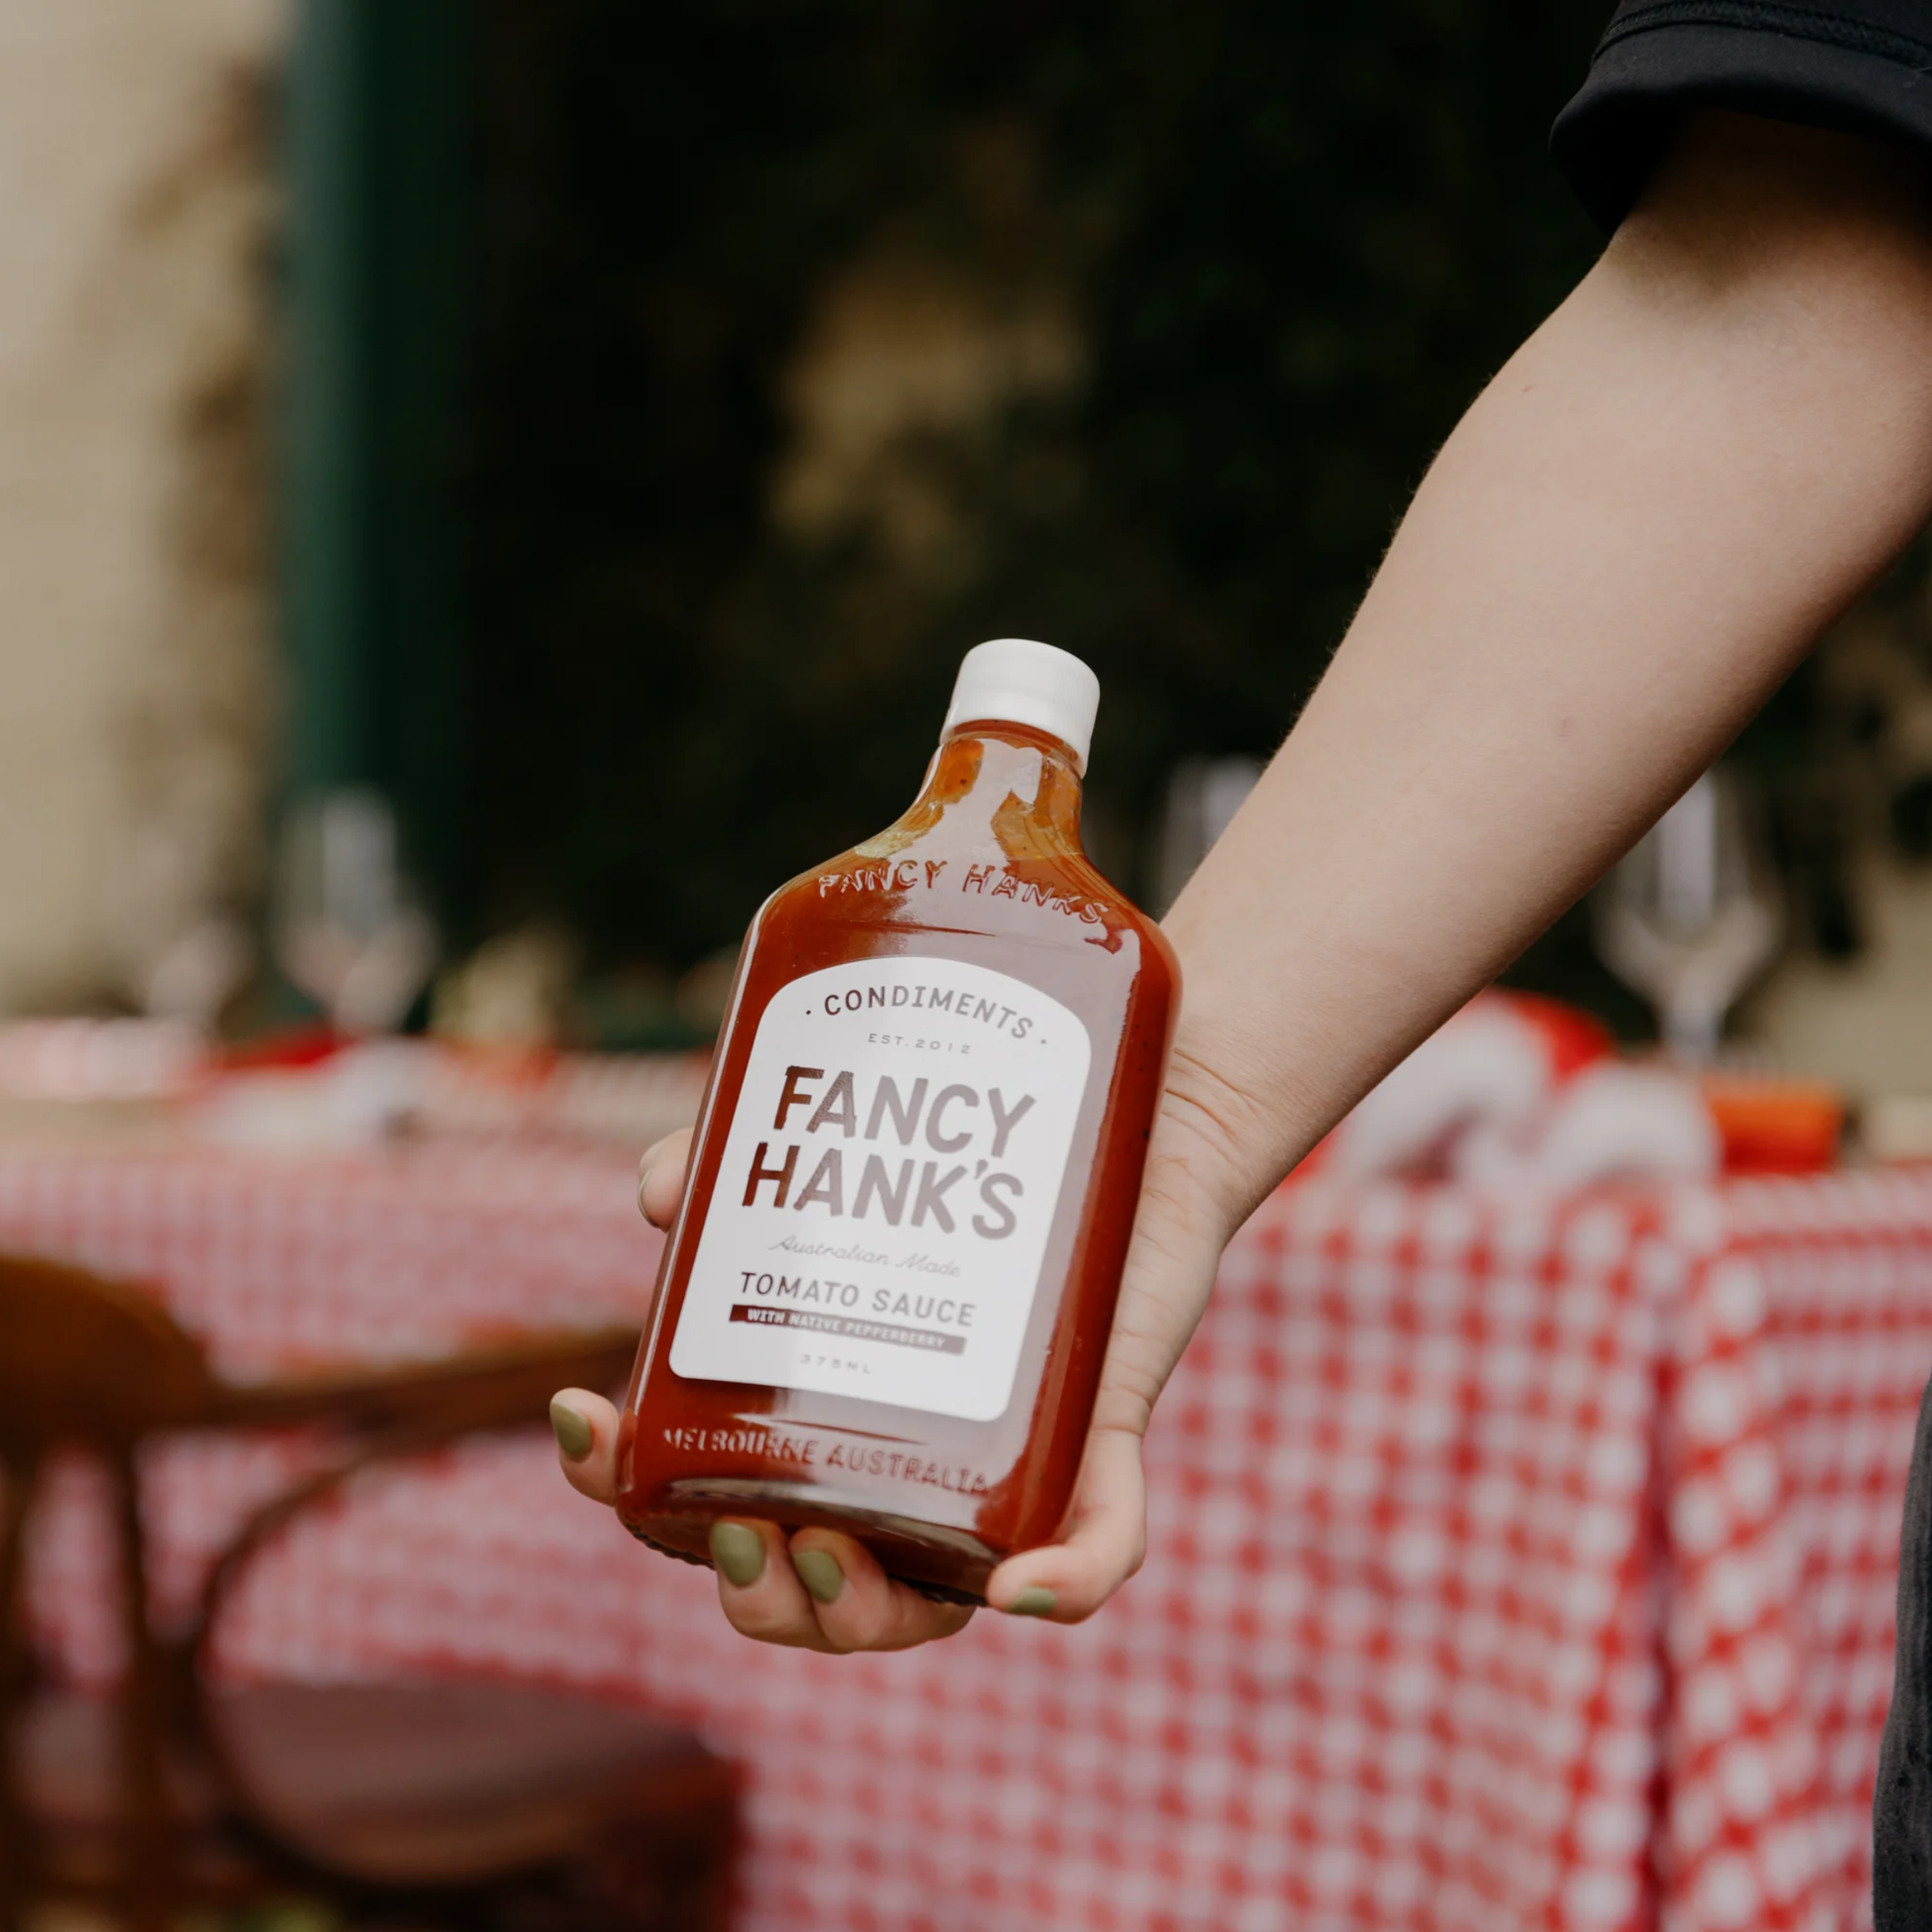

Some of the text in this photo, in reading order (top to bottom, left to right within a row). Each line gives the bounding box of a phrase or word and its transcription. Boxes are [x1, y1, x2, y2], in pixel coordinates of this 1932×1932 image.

[962, 864, 1109, 923] HANKS
[824, 985, 1034, 1039] CONDIMENTS
[773, 1065, 1036, 1159] FANCY
[742, 1142, 1024, 1240] HANK'S
[768, 1235, 962, 1278] Australian Made
[741, 1271, 976, 1327] TOMATO SAUCE
[747, 1307, 945, 1349] WITH NATIVE PEPPERBERRY
[826, 1444, 990, 1496] AUSTRALIA
